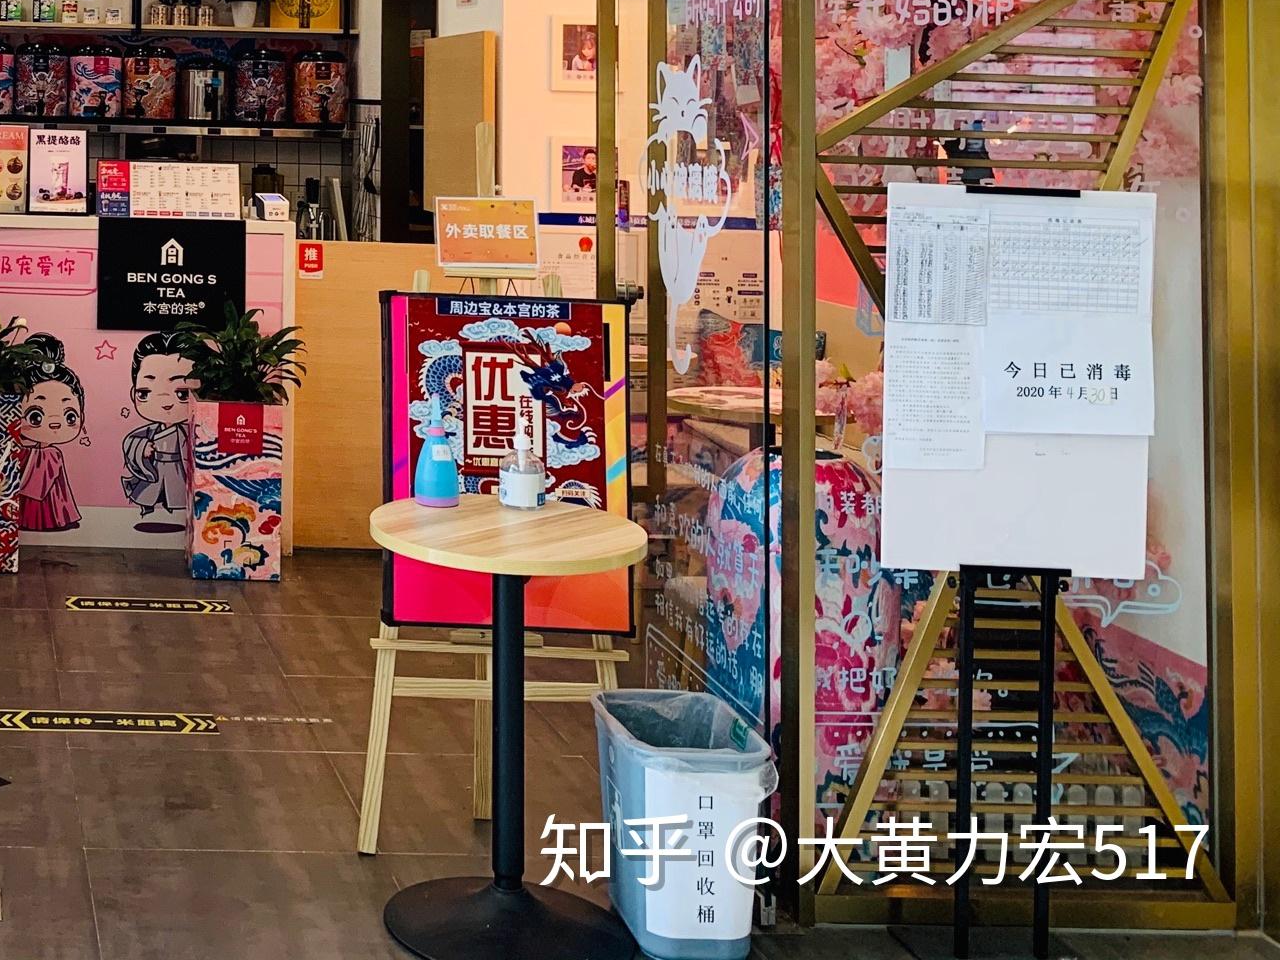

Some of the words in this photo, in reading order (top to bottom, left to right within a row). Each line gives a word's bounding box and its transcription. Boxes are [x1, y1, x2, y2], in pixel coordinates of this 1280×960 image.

[445, 224, 529, 240] 外卖取餐区
[127, 272, 157, 283] BEN
[156, 287, 186, 299] TEA
[449, 300, 560, 319] 周边宝&本宫的茶
[1003, 360, 1132, 382] 今日已消毒
[471, 355, 516, 450] 优惠
[696, 794, 716, 925] 口罩回收桶
